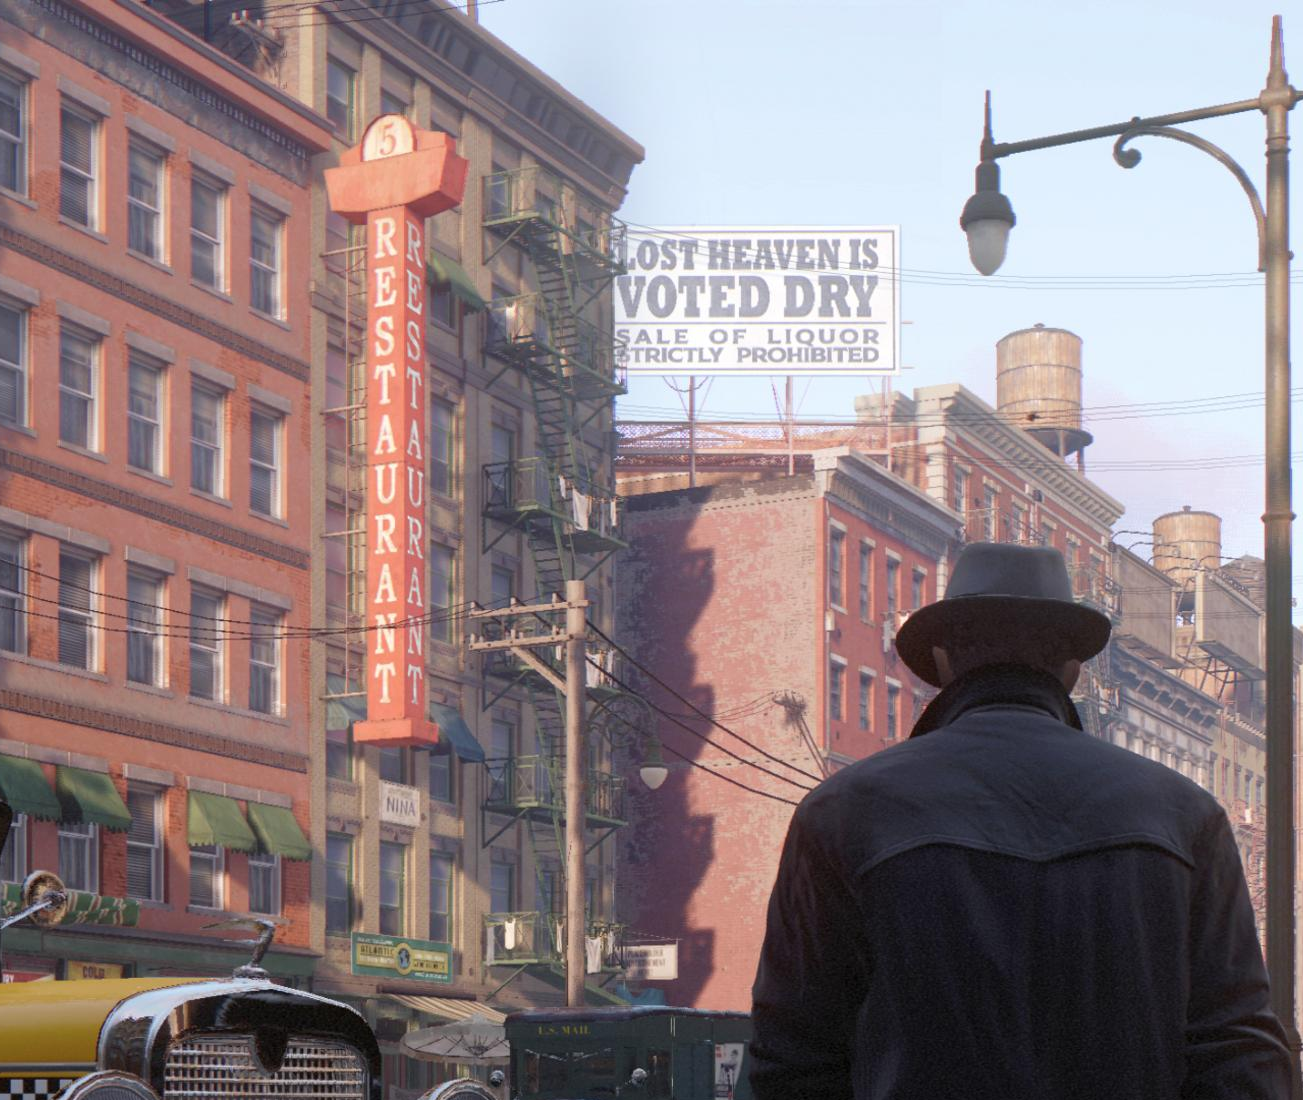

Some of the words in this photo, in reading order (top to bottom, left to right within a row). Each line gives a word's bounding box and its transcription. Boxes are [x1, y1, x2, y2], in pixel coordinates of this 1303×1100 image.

[380, 121, 397, 156] 5
[615, 239, 698, 270] LOST
[708, 239, 841, 270] HEAVEN
[849, 239, 879, 270] IS
[616, 274, 770, 318] VOTED
[784, 275, 879, 318] DRY
[616, 329, 689, 345] SALE
[709, 329, 746, 345] OF
[767, 328, 880, 347] LIQUOR
[616, 347, 724, 363] STRICTLY
[737, 347, 880, 363] PROHIBITED
[372, 216, 398, 704] RESTAURANT
[405, 220, 424, 705] RESTAURANT
[386, 796, 415, 817] NINA
